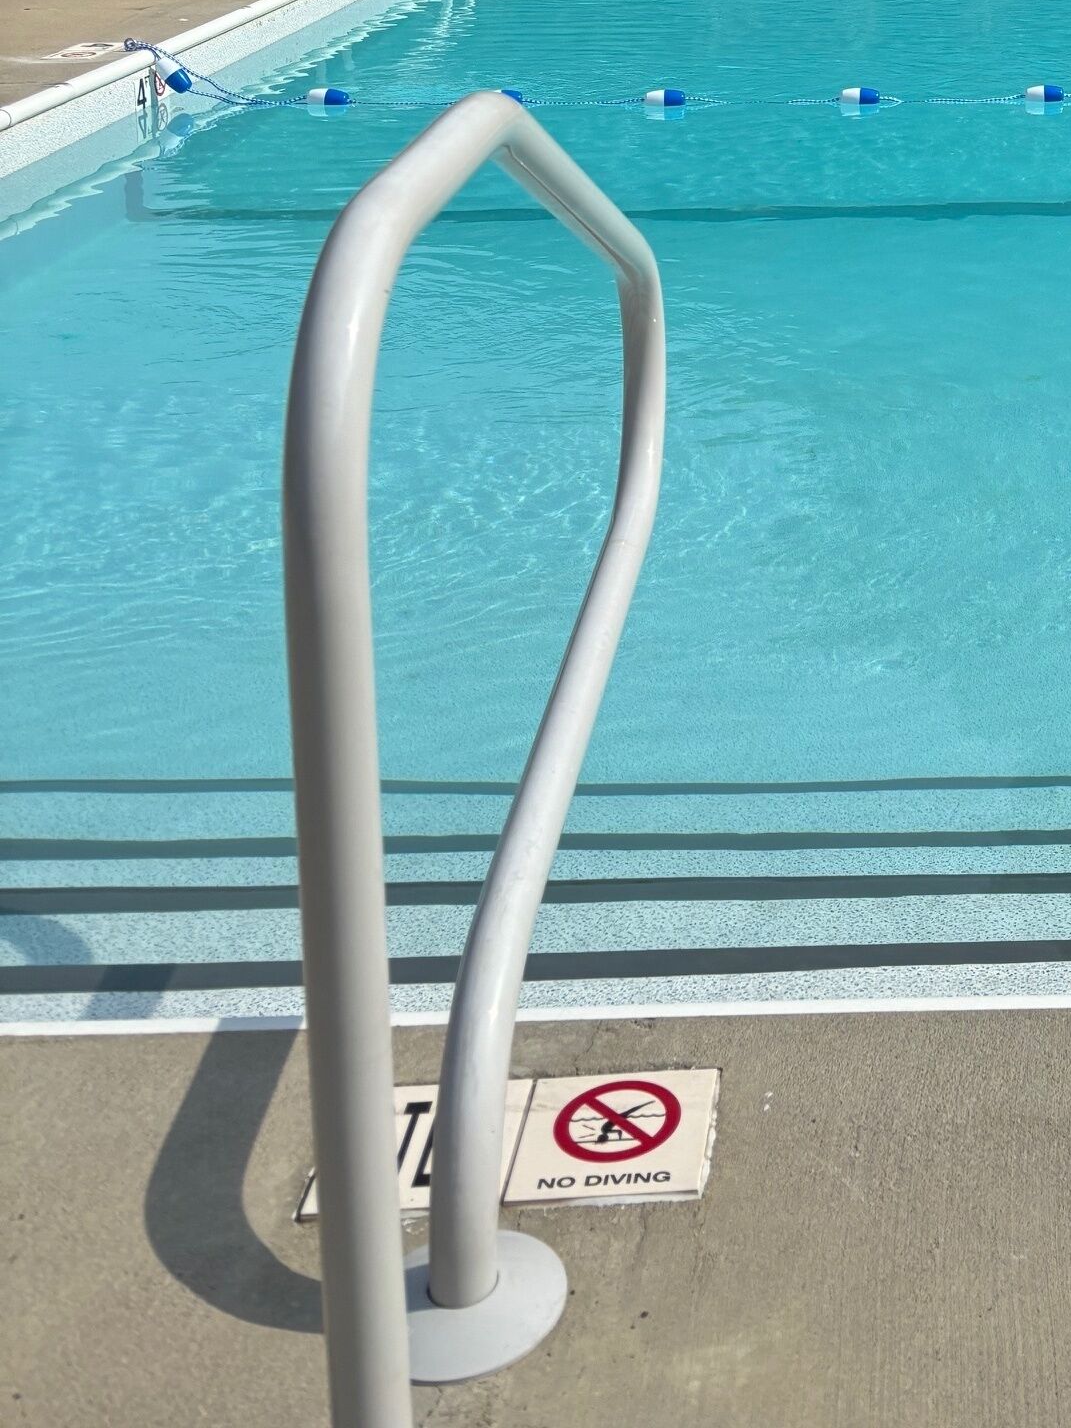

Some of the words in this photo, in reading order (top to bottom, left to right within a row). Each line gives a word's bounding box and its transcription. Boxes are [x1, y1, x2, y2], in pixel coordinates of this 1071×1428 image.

[137, 78, 147, 109] 4
[537, 1176, 576, 1190] NO
[584, 1170, 672, 1187] DIVING
